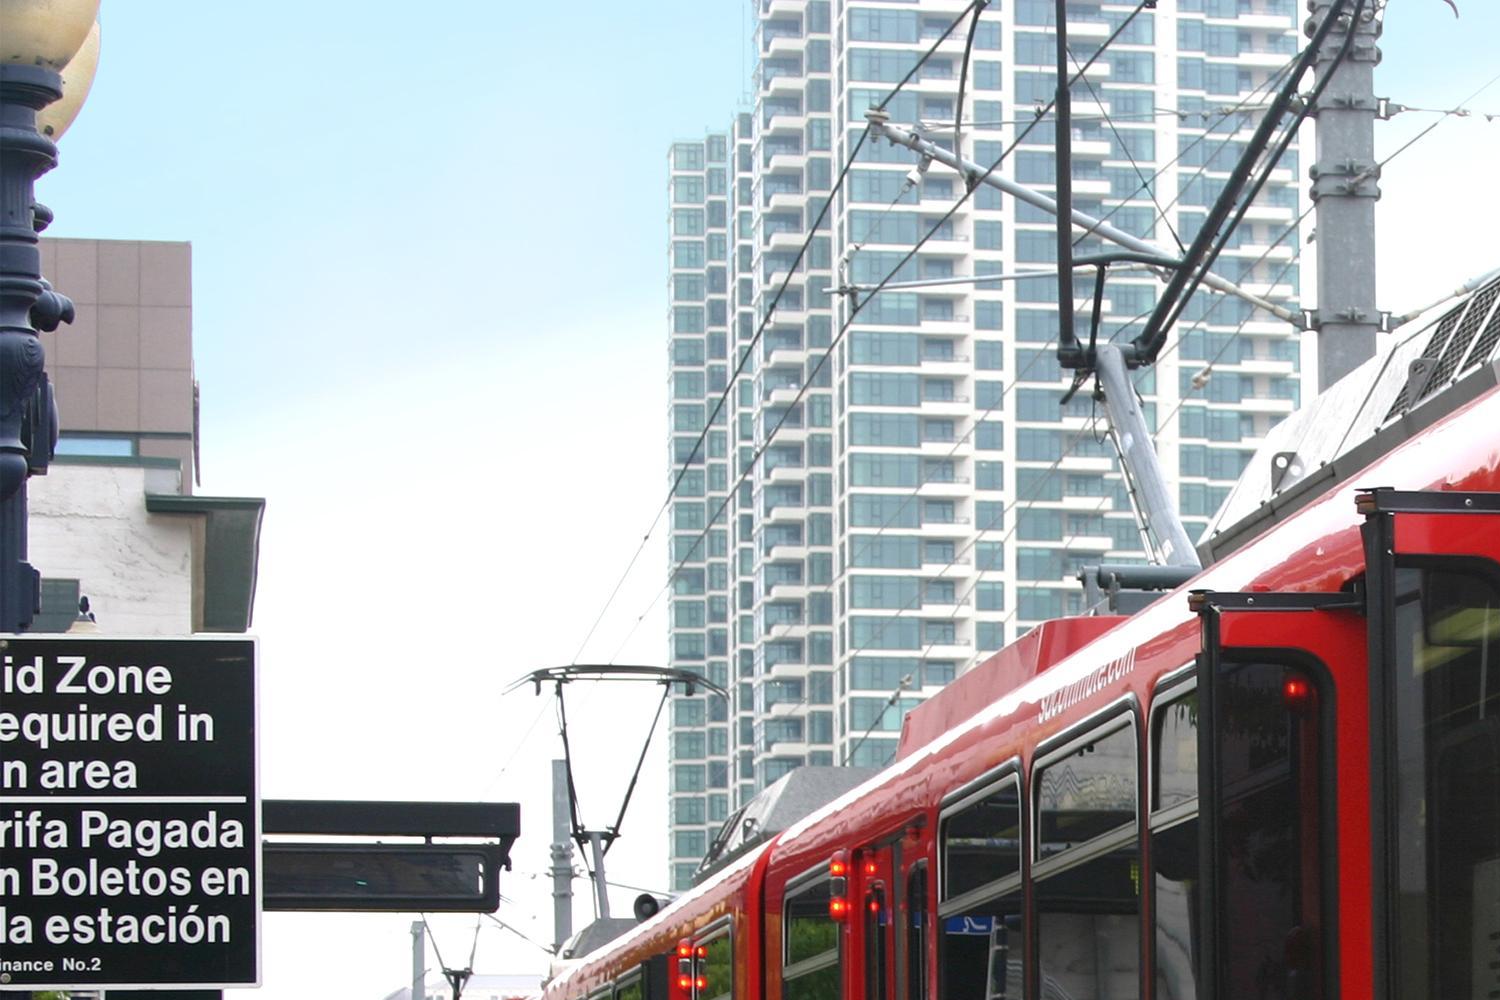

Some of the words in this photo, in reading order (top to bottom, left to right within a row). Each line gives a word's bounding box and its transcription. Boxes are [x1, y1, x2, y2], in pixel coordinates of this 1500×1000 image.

[55, 655, 173, 694] Zone
[0, 703, 163, 750] equired
[177, 703, 214, 741] in
[39, 760, 138, 789] area
[81, 810, 244, 857] Pagada
[32, 858, 192, 897] Boletos
[200, 867, 250, 896] en
[0, 906, 33, 944] la
[45, 904, 231, 944] estación
[62, 957, 102, 972] No.2
